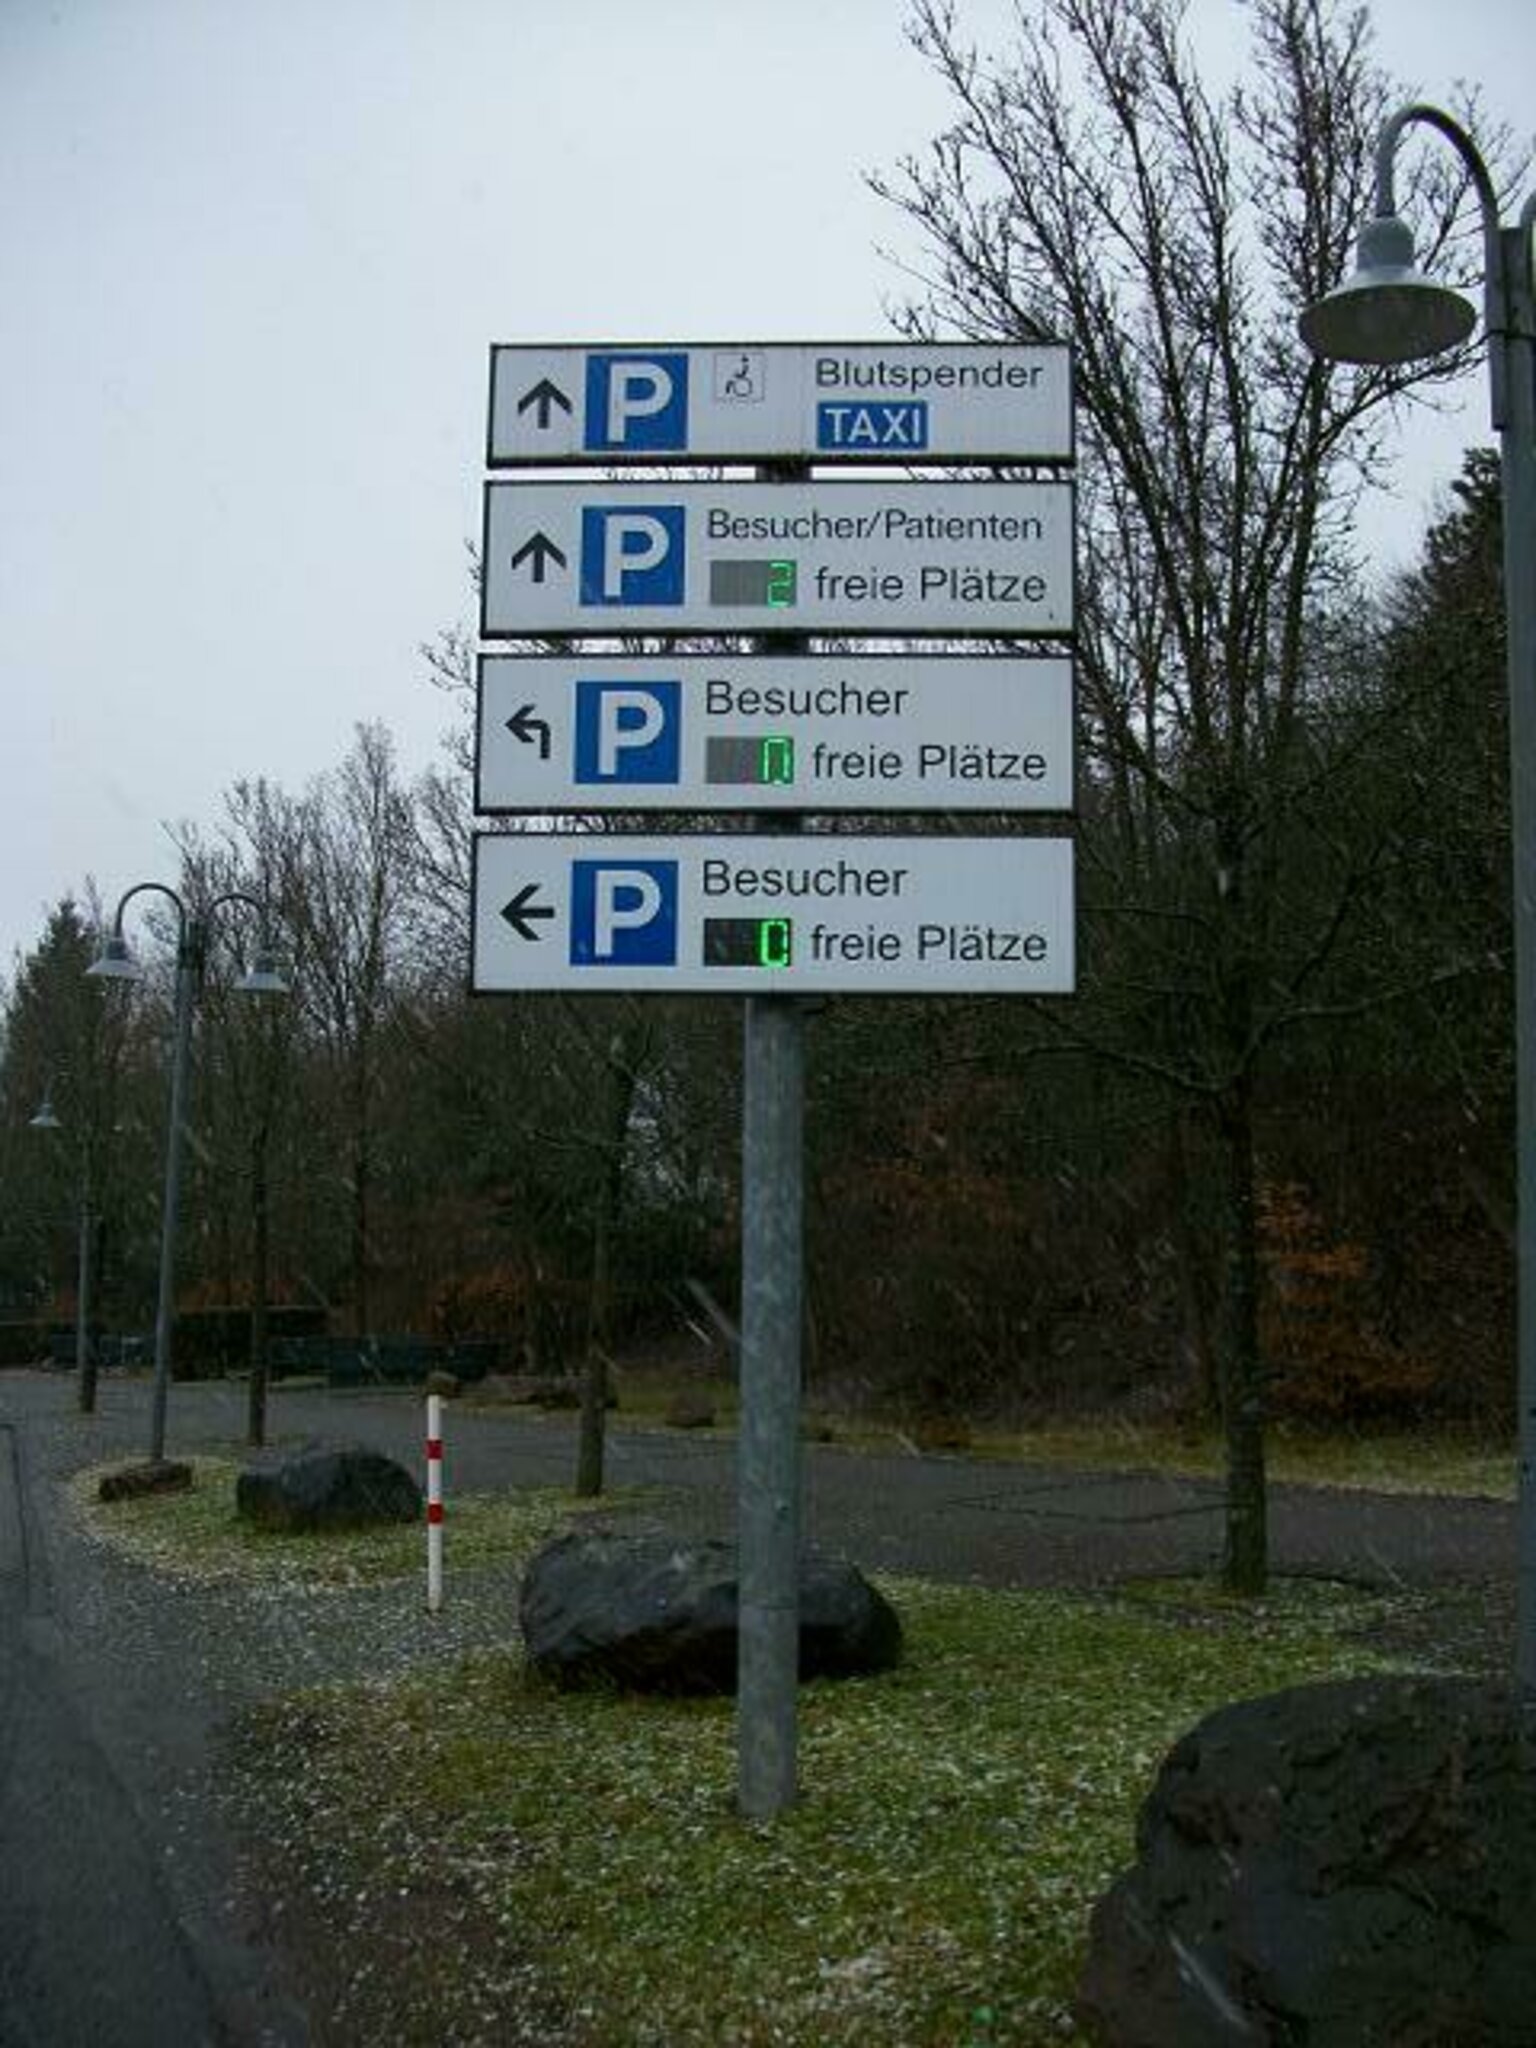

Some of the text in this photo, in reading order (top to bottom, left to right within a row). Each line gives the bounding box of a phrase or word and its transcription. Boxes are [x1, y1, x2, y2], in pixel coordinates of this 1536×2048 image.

[815, 359, 1044, 392] Blutspender
[606, 361, 673, 442] P
[825, 408, 921, 443] TAXI
[706, 508, 1043, 541] Besucher/Patienten
[603, 514, 670, 597] P
[766, 561, 1047, 609] 2 freie Plätze
[705, 681, 909, 716] Besucher
[599, 690, 665, 776] P
[812, 744, 901, 780] freie
[918, 744, 1047, 780] Plätze
[702, 860, 908, 897] Besucher
[593, 869, 662, 956] P
[758, 919, 1048, 967] 0 freie Plätze
